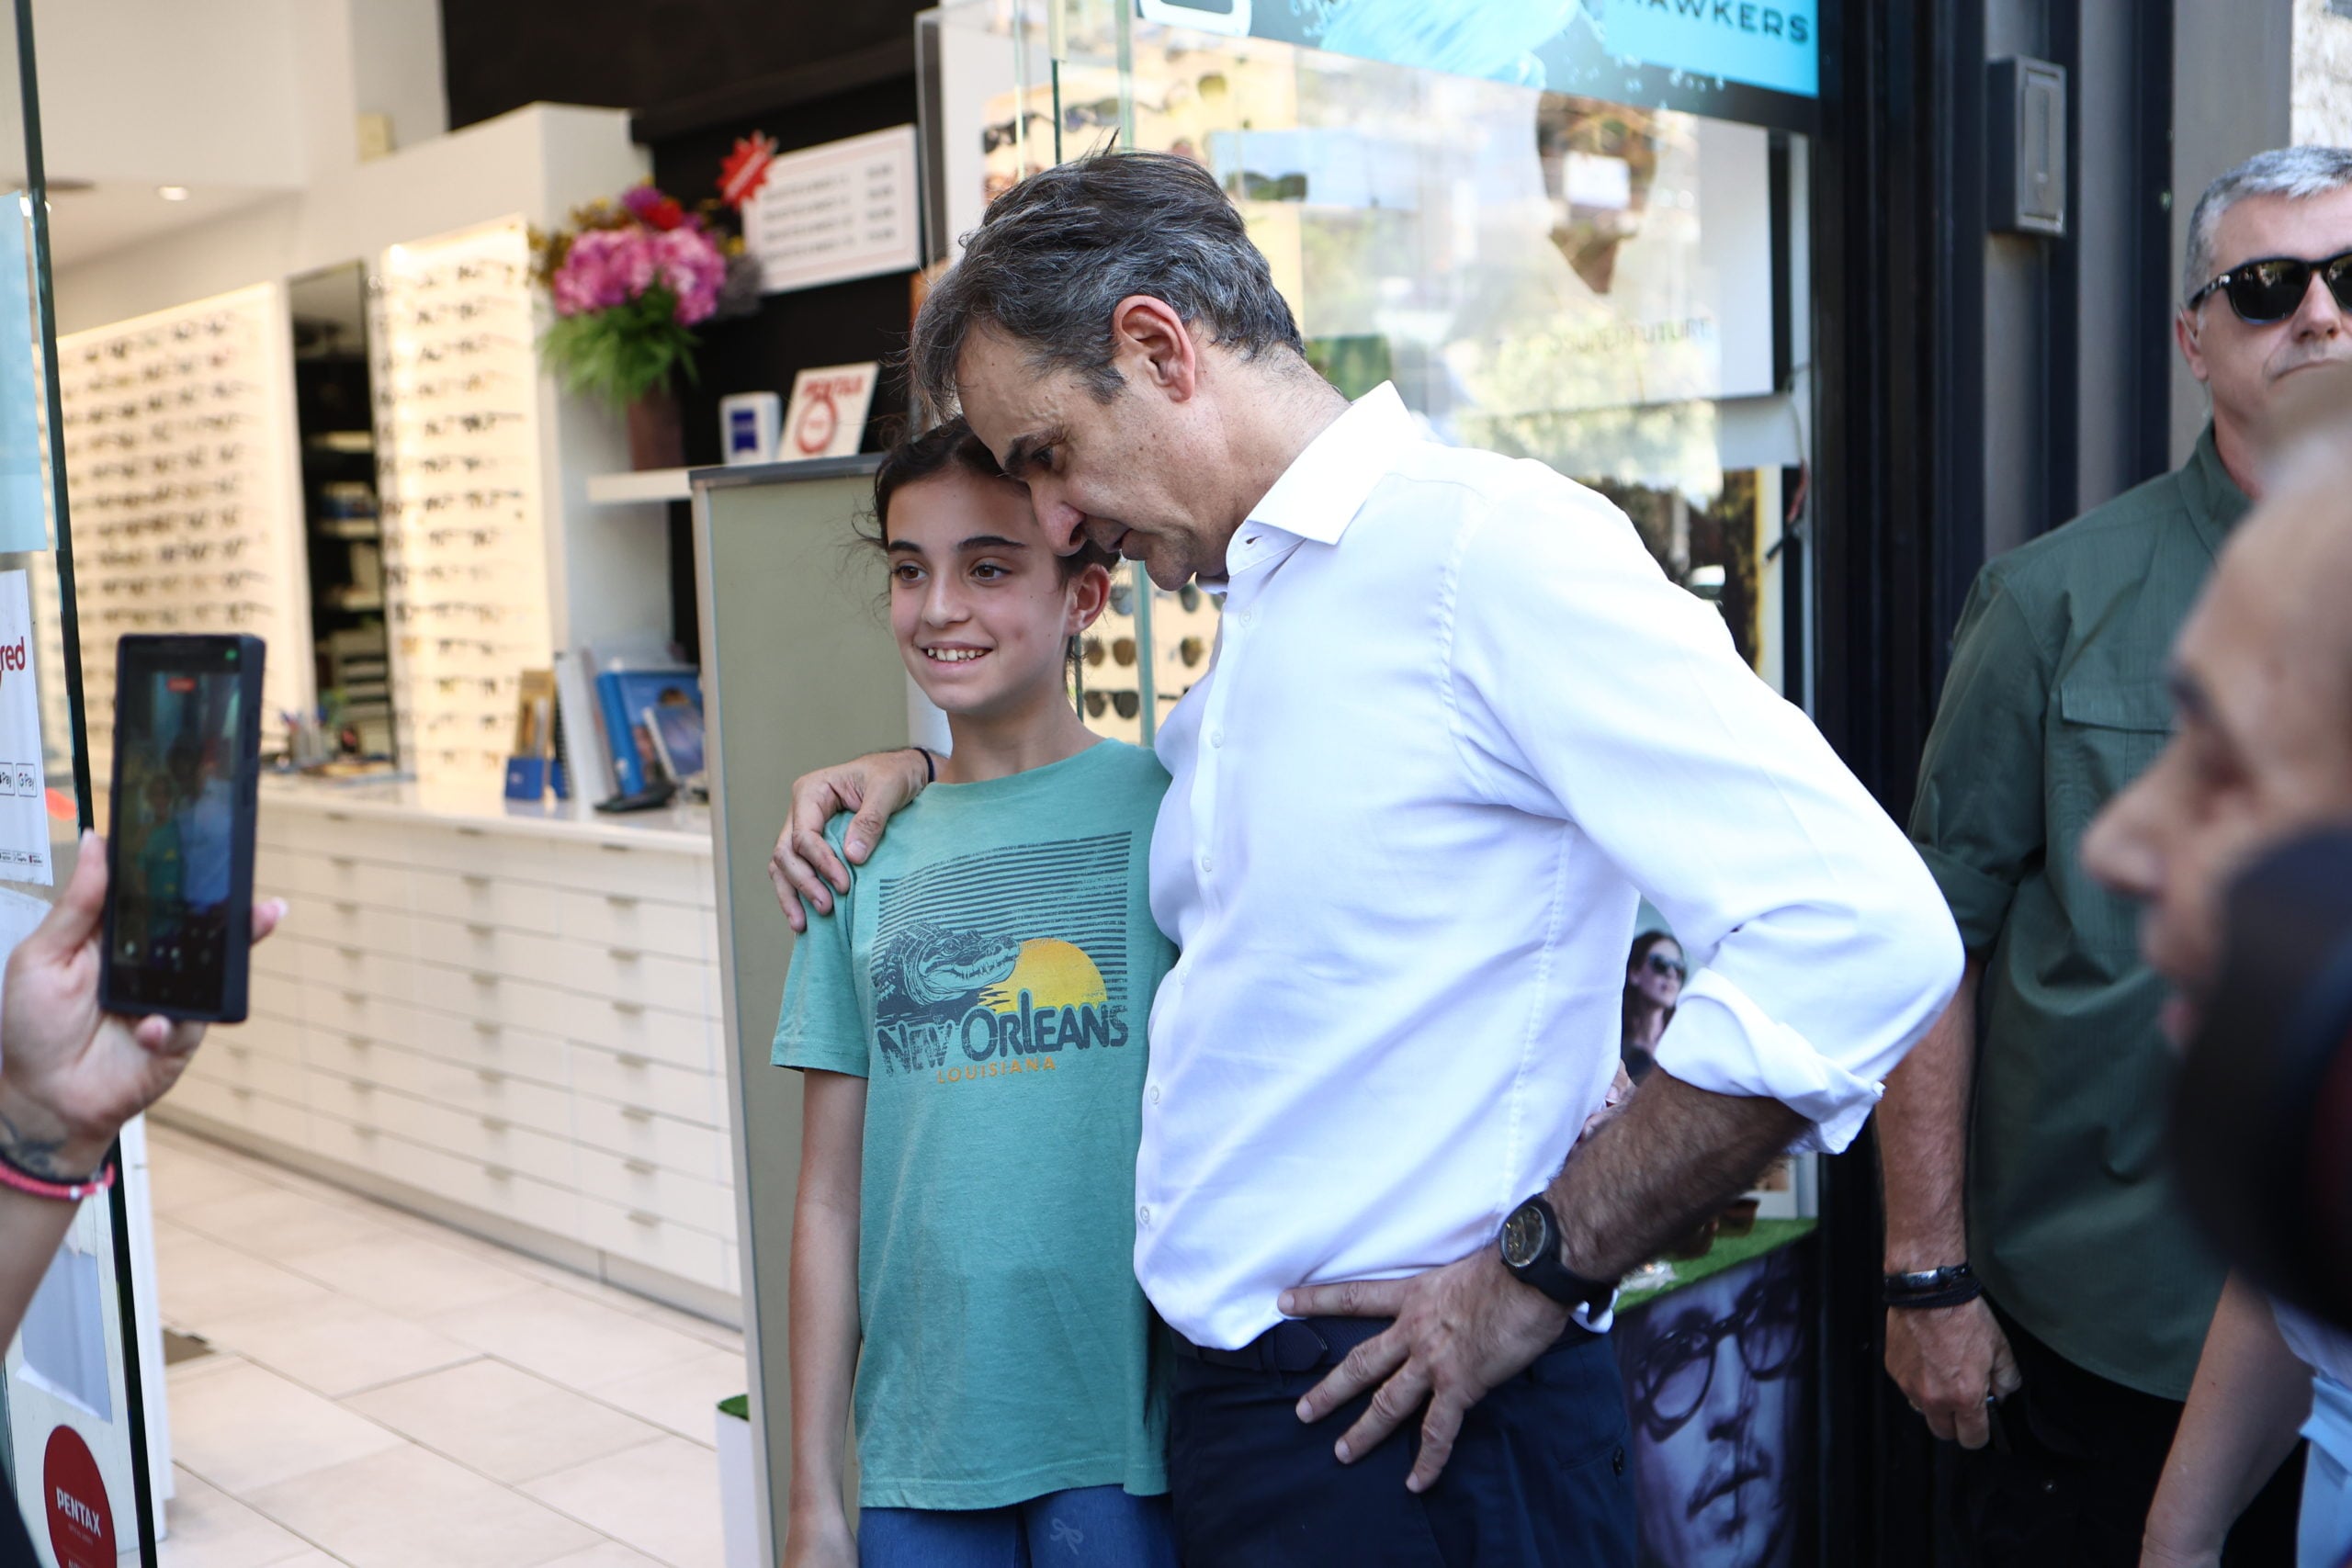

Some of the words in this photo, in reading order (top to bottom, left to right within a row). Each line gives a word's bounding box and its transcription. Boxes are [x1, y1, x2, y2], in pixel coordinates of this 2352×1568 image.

[1620, 0, 1809, 43] AWKERS
[876, 1021, 953, 1077] NEW
[961, 990, 1129, 1062] ORLEANS
[936, 1055, 1056, 1084] LOUISIANA
[56, 1485, 102, 1539] PENTAX
